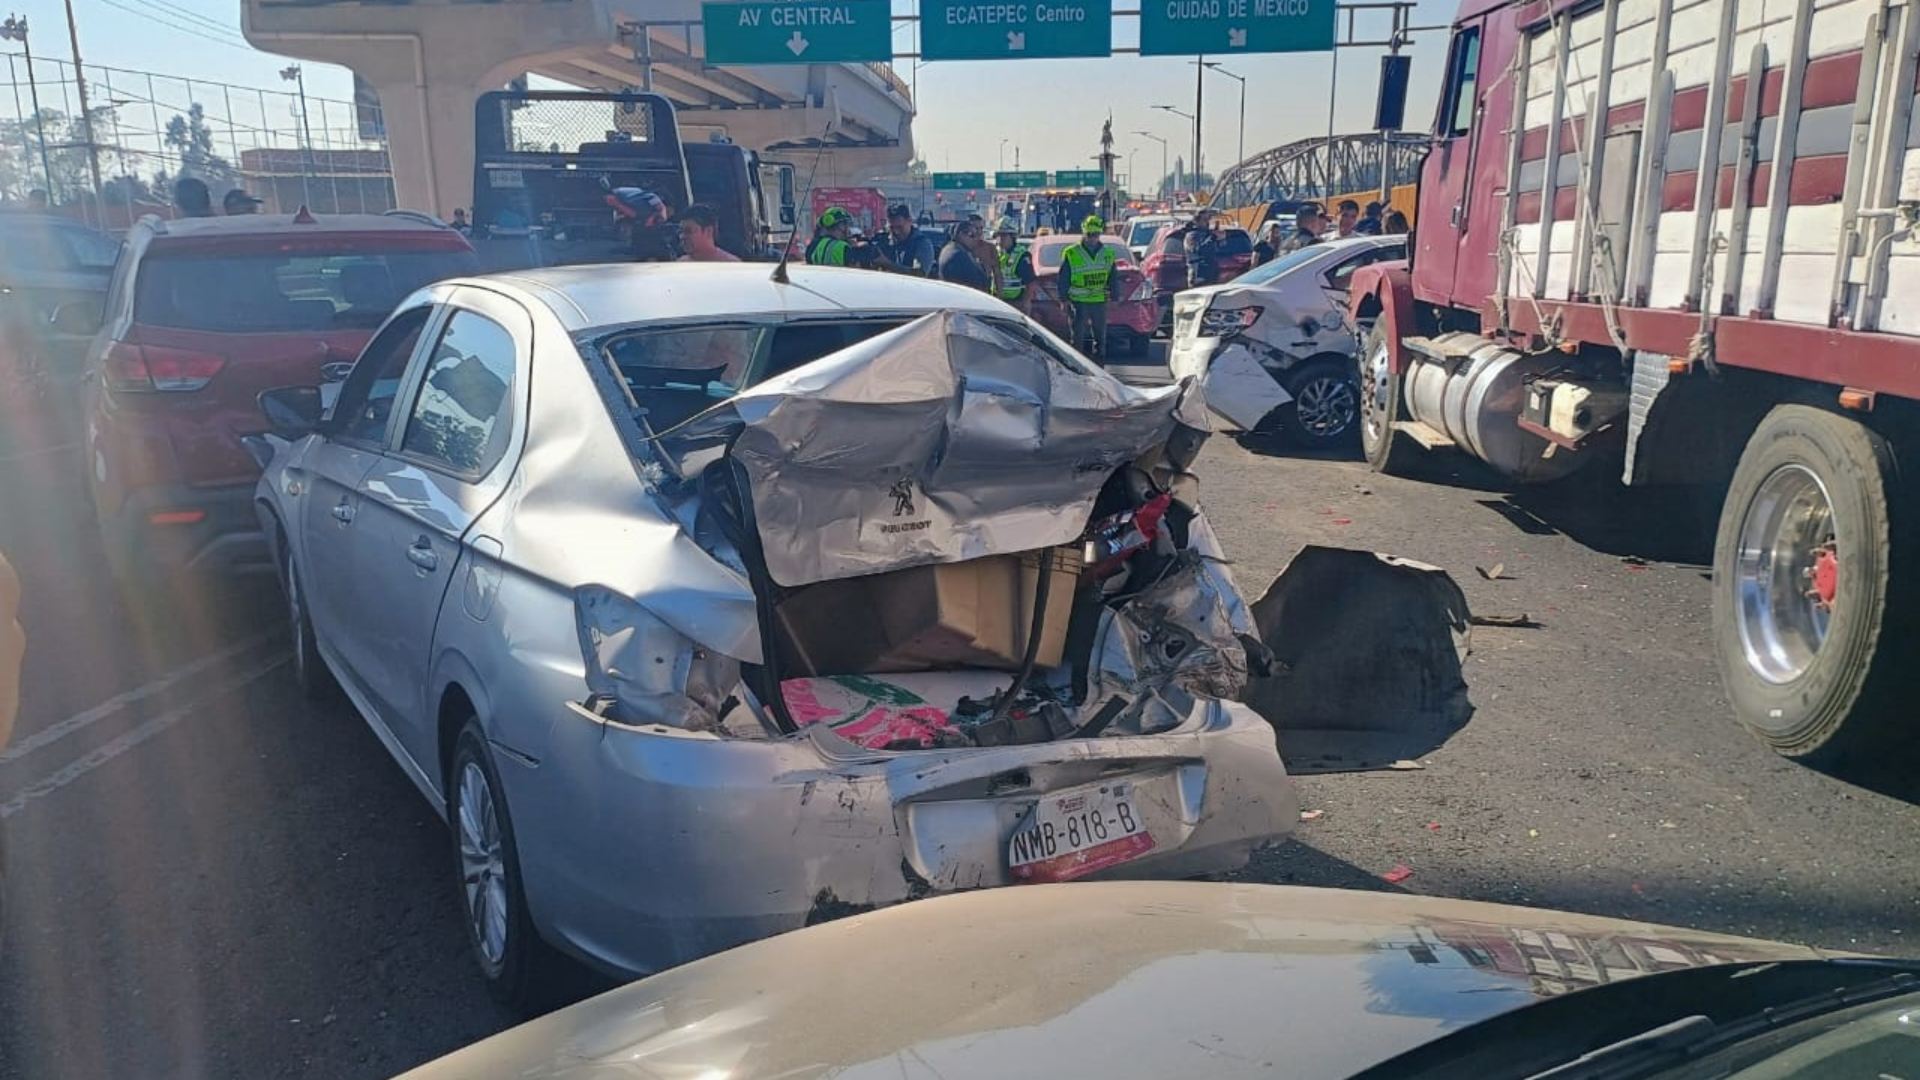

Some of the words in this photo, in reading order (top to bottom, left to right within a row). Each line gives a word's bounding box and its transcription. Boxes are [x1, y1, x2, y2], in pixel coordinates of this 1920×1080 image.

[739, 8, 761, 26] AV
[771, 7, 856, 26] CENTRAL
[946, 4, 1027, 24] ECATEPEC
[1036, 4, 1085, 22] Centro
[1167, 0, 1220, 19] CIUDAD
[1228, 0, 1247, 17] DE
[1013, 802, 1136, 862] NMB-818-B
